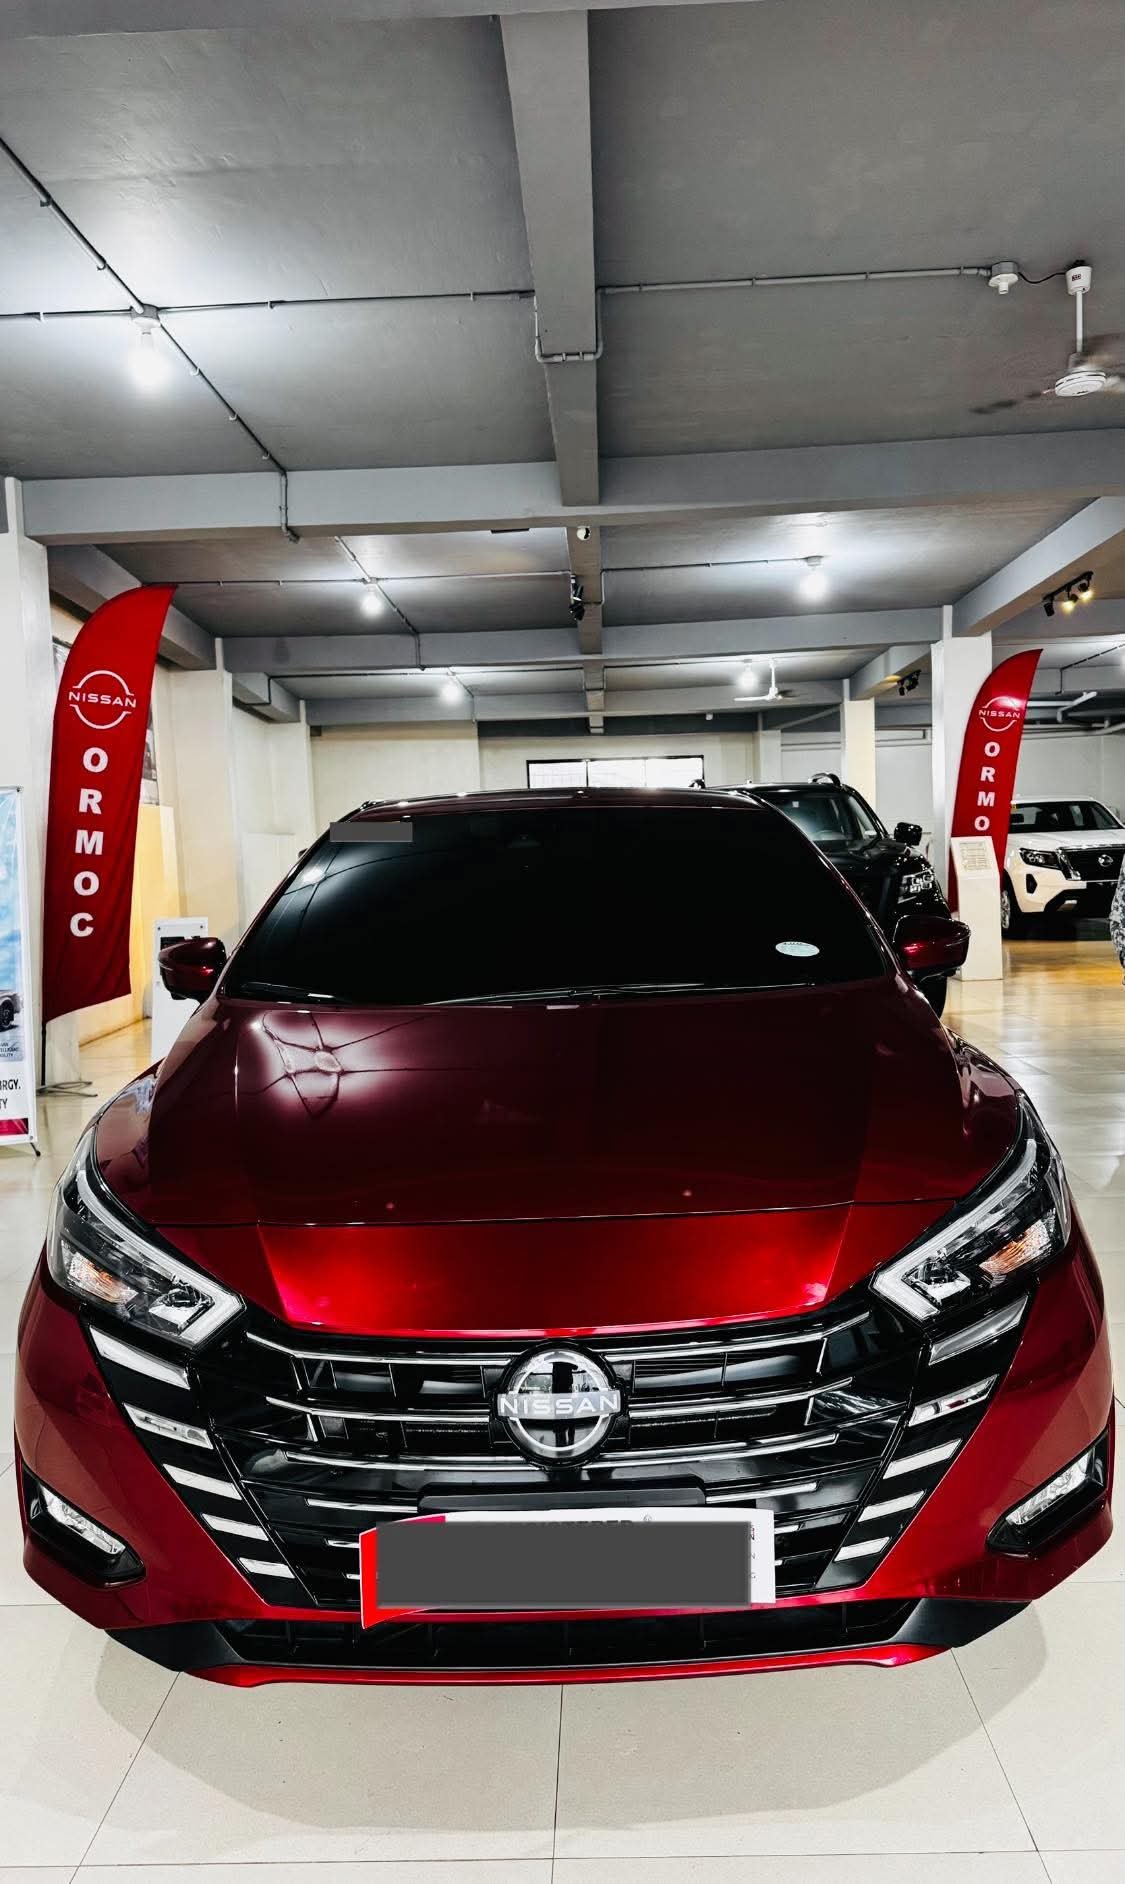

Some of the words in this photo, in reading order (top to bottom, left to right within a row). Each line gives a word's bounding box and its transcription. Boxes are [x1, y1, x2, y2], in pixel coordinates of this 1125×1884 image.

[68, 691, 136, 708] NISSAN
[978, 709, 1021, 719] NISSAN
[69, 746, 109, 938] ORMOC
[0, 1078, 21, 1091] RGY.
[500, 1393, 618, 1415] NISSAN
